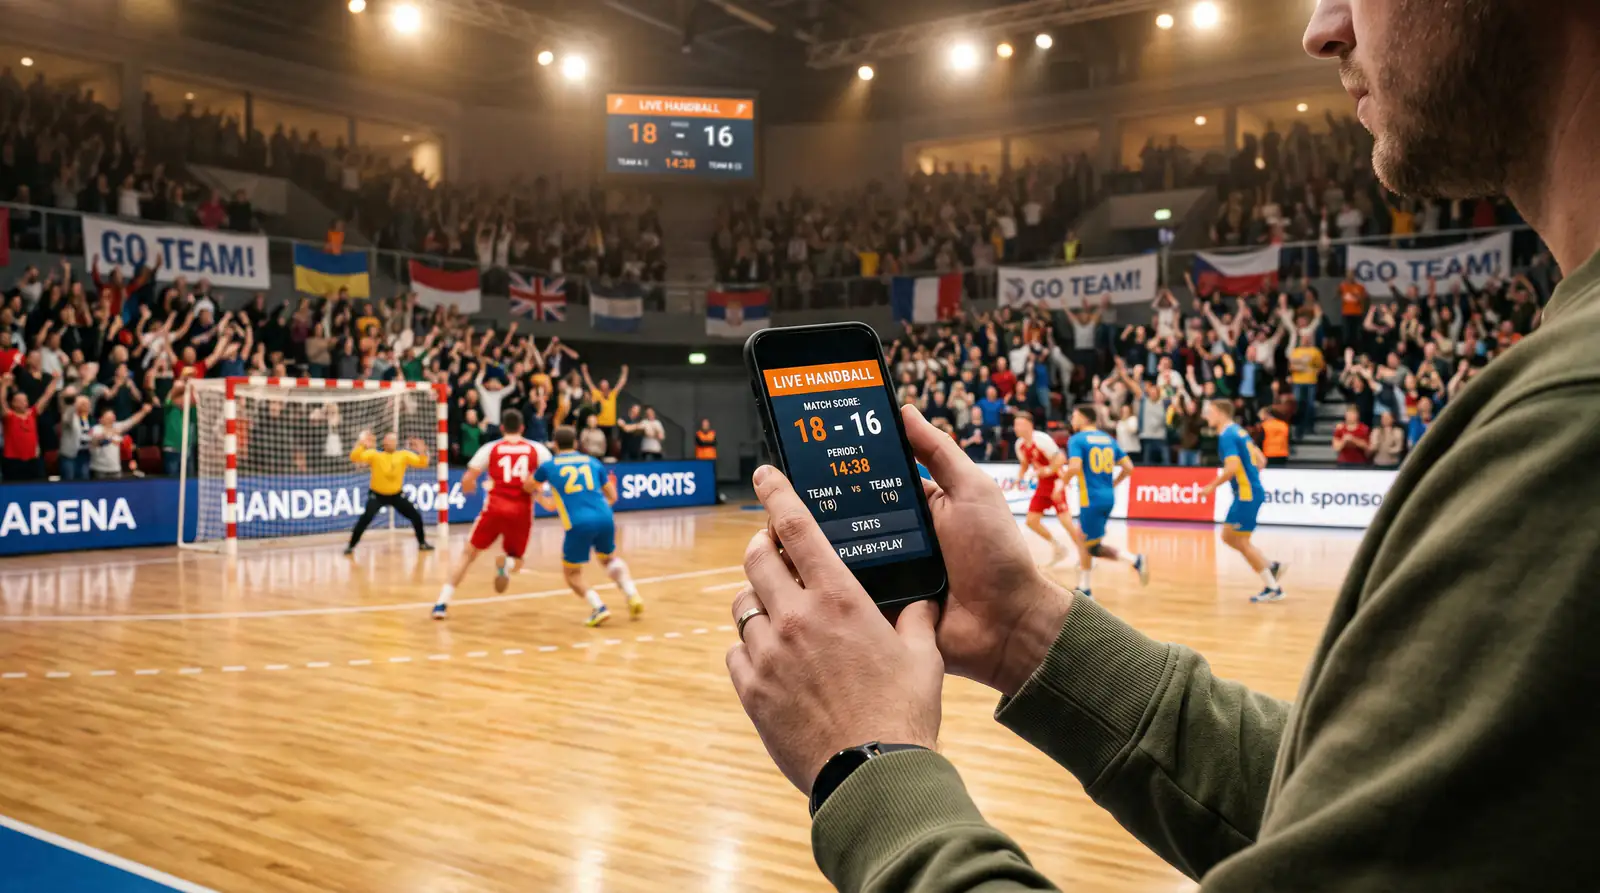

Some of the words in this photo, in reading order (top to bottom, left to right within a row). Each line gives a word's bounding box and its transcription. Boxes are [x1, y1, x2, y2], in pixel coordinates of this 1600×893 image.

[638, 99, 662, 111] LIVE
[664, 101, 721, 114] HANDBALL
[628, 122, 658, 144] 18
[703, 124, 734, 147] 16
[101, 230, 147, 266] GO
[156, 236, 256, 277] TEAM!
[1355, 259, 1398, 282] GO
[1030, 277, 1064, 299] GO
[1069, 269, 1142, 297] TEAM!
[773, 374, 803, 389] LIVE
[805, 367, 875, 387] HANDBALL
[803, 400, 832, 411] MATCH
[833, 397, 861, 408] SCORE:
[794, 415, 827, 443] 18
[849, 409, 882, 437] 16
[826, 446, 858, 458] PERIOD:
[859, 445, 864, 454] 1
[1089, 446, 1115, 475] 08
[497, 454, 529, 484] 14
[560, 463, 595, 494] 21
[829, 457, 871, 477] 14:38
[621, 471, 697, 499] SPORTS
[807, 486, 834, 499] TEAM
[835, 485, 843, 495] A
[869, 478, 895, 490] TEAM
[895, 477, 903, 487] B
[220, 486, 387, 523] HANDBAL
[819, 498, 838, 513] (18)
[881, 490, 899, 504] (16)
[1263, 487, 1305, 505] atch
[1311, 491, 1384, 510] sponso
[0, 496, 137, 537] ARENA
[851, 518, 881, 532] STATS
[839, 538, 903, 559] PLAY-BY-PLAY
